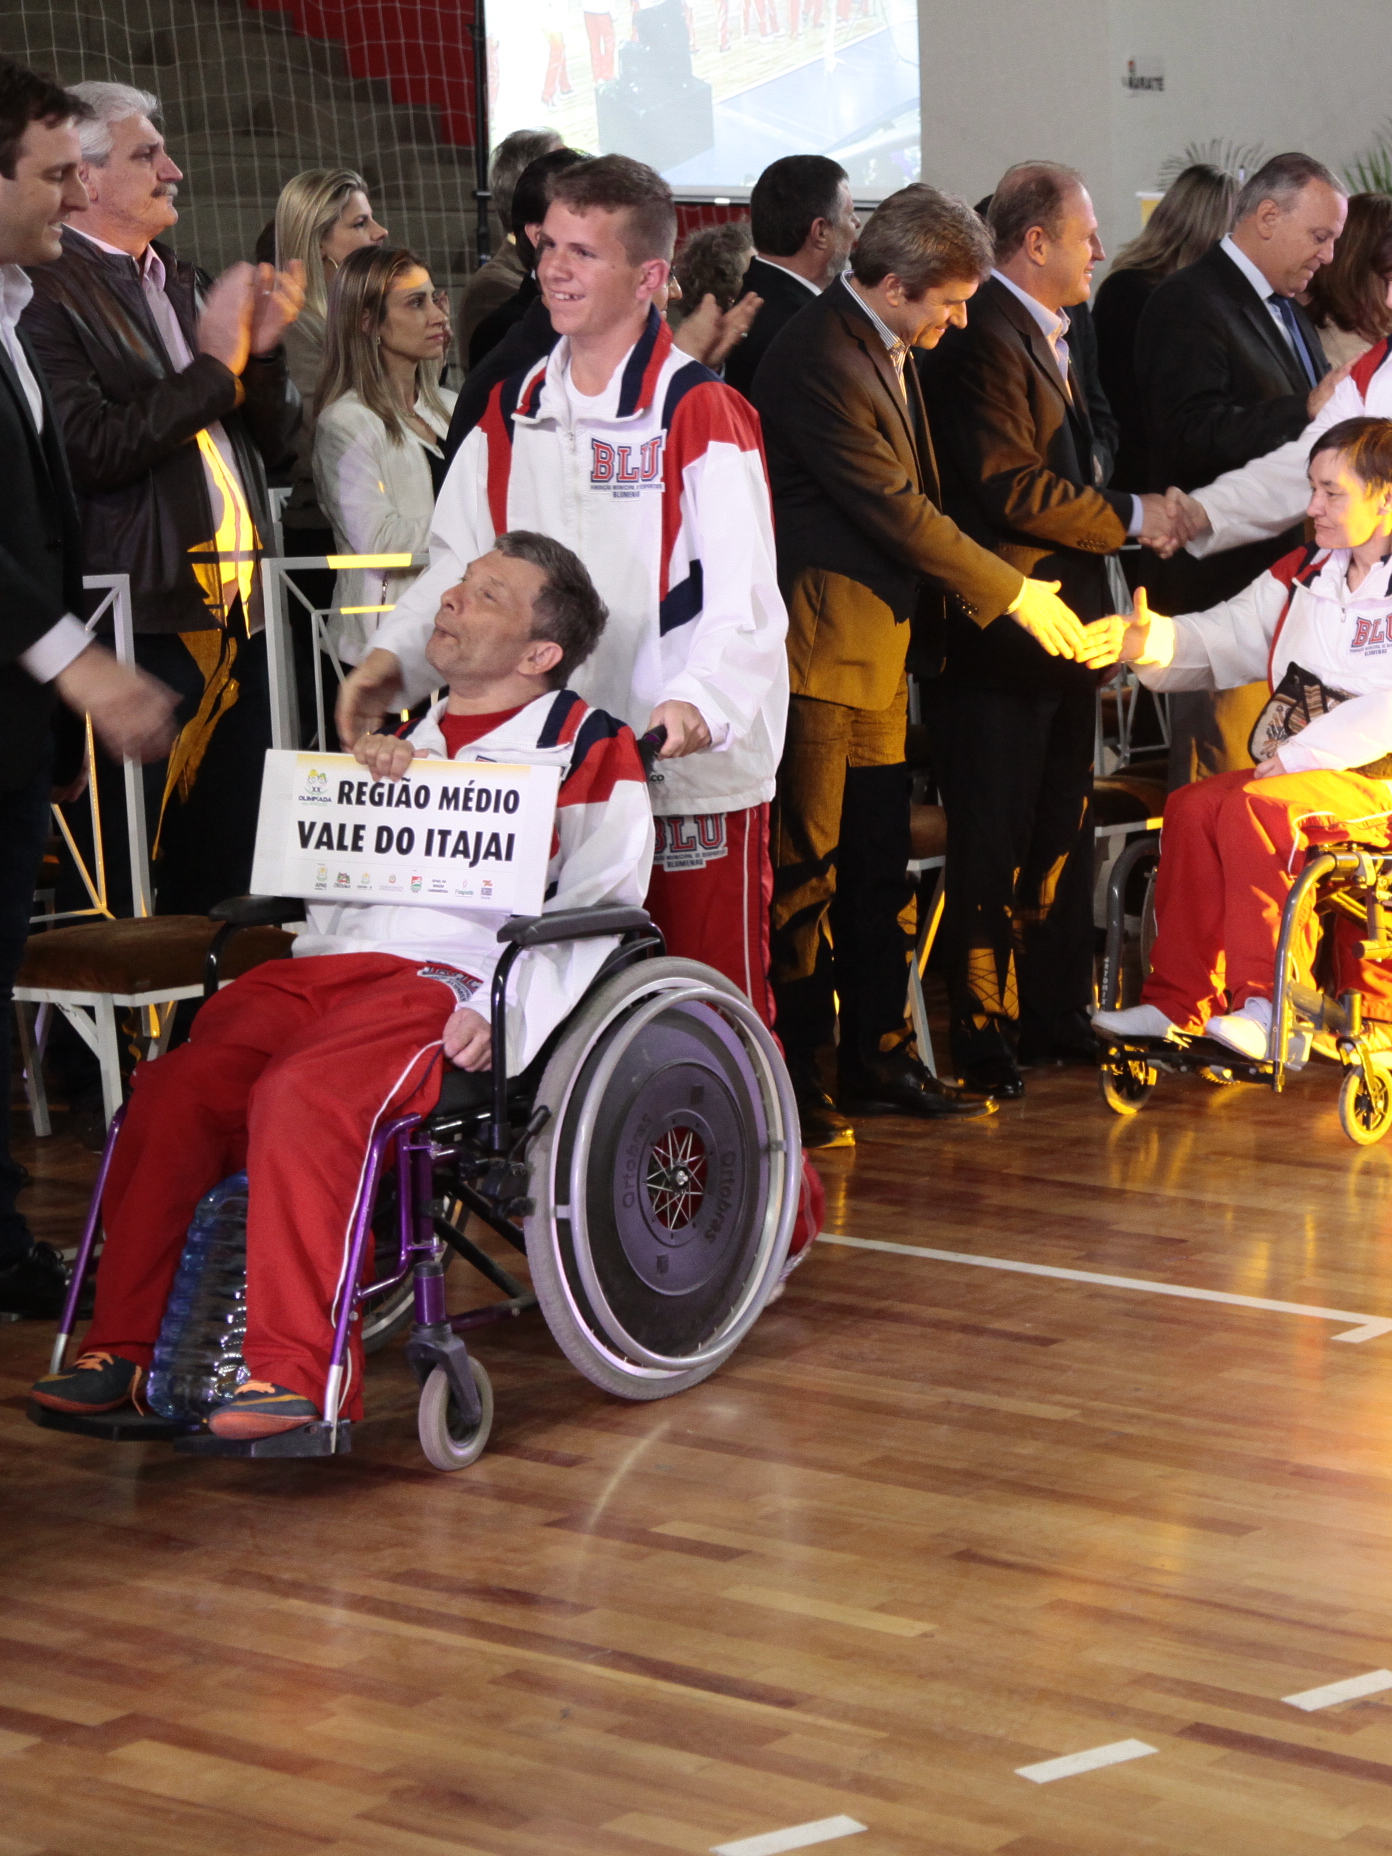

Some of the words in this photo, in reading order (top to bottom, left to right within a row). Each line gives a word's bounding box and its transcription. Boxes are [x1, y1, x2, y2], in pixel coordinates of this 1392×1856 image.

[591, 435, 662, 482] BLU
[337, 777, 431, 809] REGIÃO
[438, 780, 520, 814] MÉDIO
[297, 820, 366, 852] VALE
[374, 825, 415, 855] DO
[424, 828, 515, 868] ITAJAI
[704, 1151, 736, 1244] Ortobras
